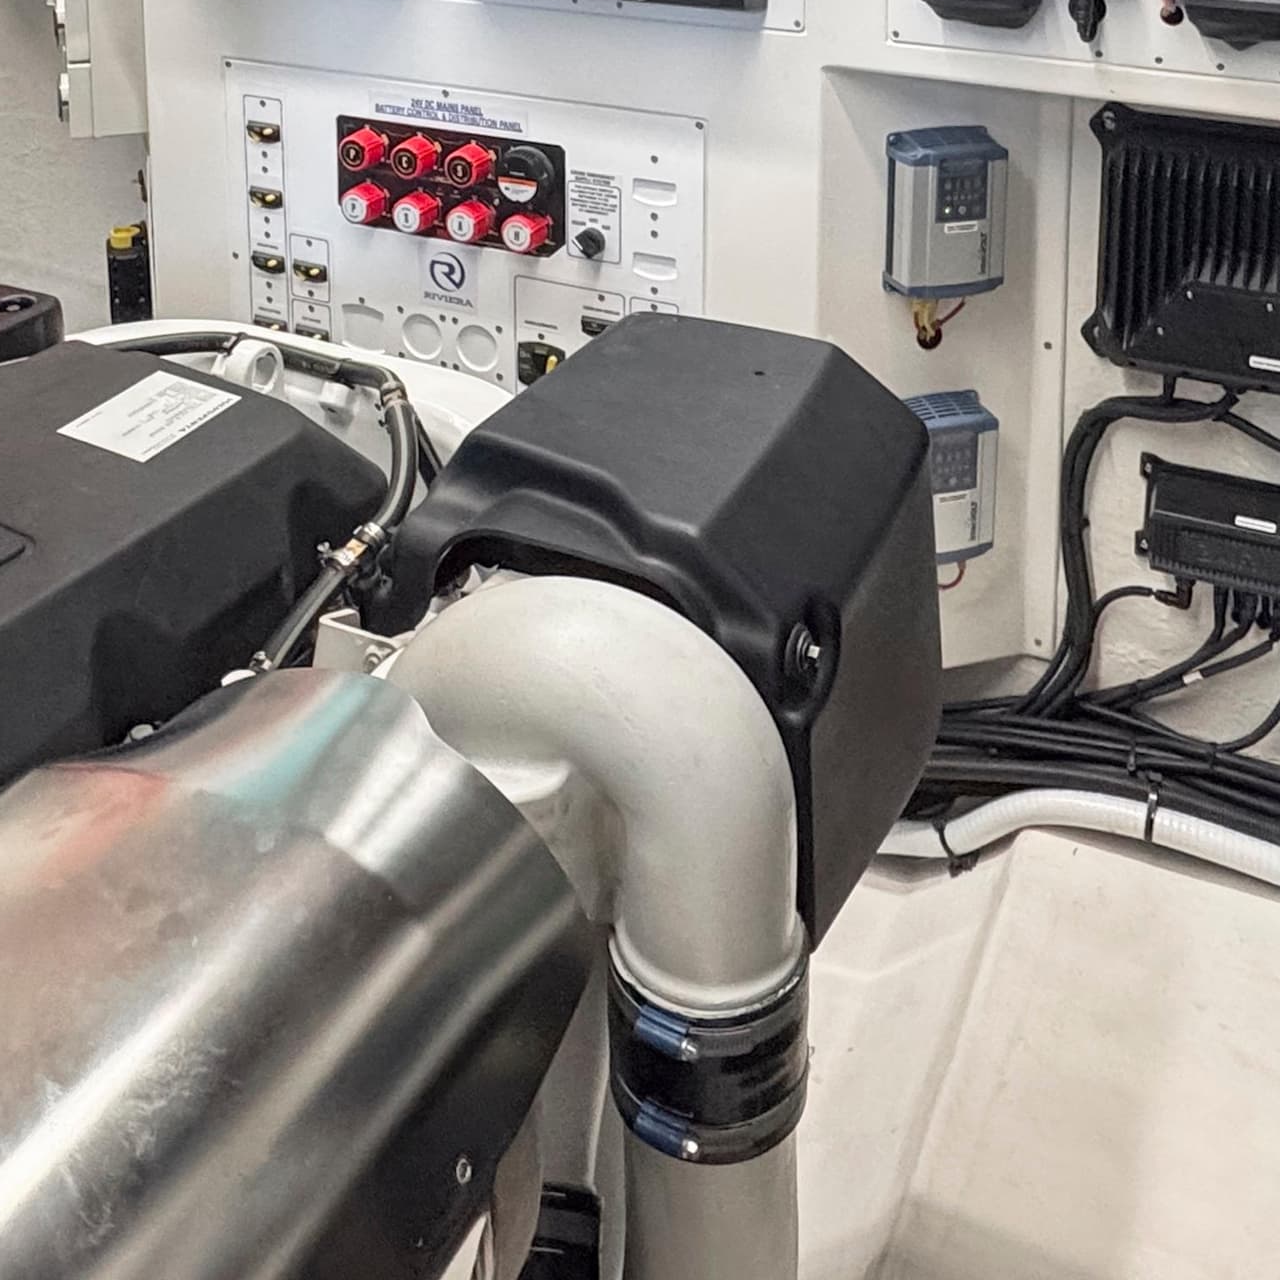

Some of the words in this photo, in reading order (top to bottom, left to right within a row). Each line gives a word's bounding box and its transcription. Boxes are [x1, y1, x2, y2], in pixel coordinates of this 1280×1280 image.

[375, 103, 405, 115] BATTERY
[406, 108, 438, 121] CONTROL
[448, 112, 497, 128] DISTRIBUTION
[499, 120, 523, 133] PANEL
[460, 104, 483, 116] PANEL
[424, 291, 474, 308] RIVIERA
